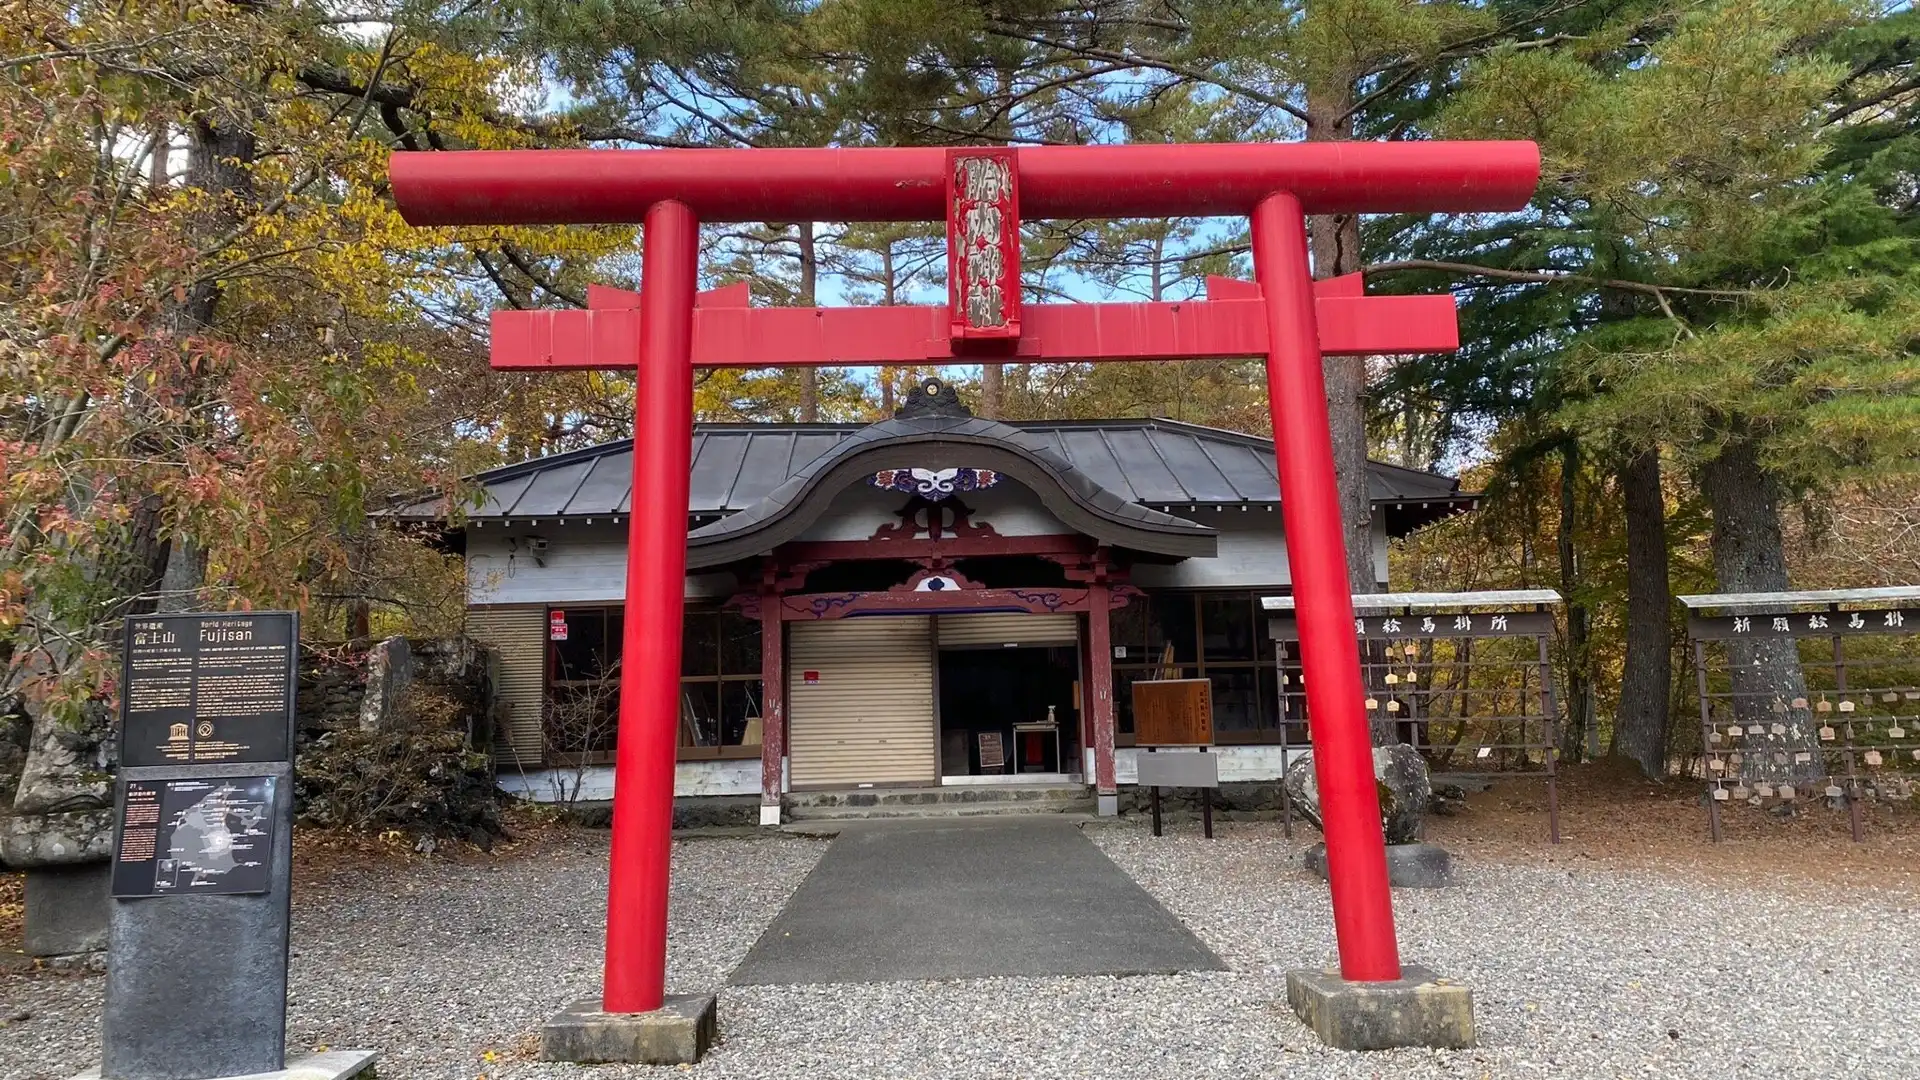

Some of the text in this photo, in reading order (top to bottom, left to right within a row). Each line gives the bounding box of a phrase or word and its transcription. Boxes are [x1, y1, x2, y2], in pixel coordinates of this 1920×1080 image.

[200, 620, 253, 628] World Heritage
[134, 631, 175, 645] 富士山
[199, 629, 252, 643] Fujisan
